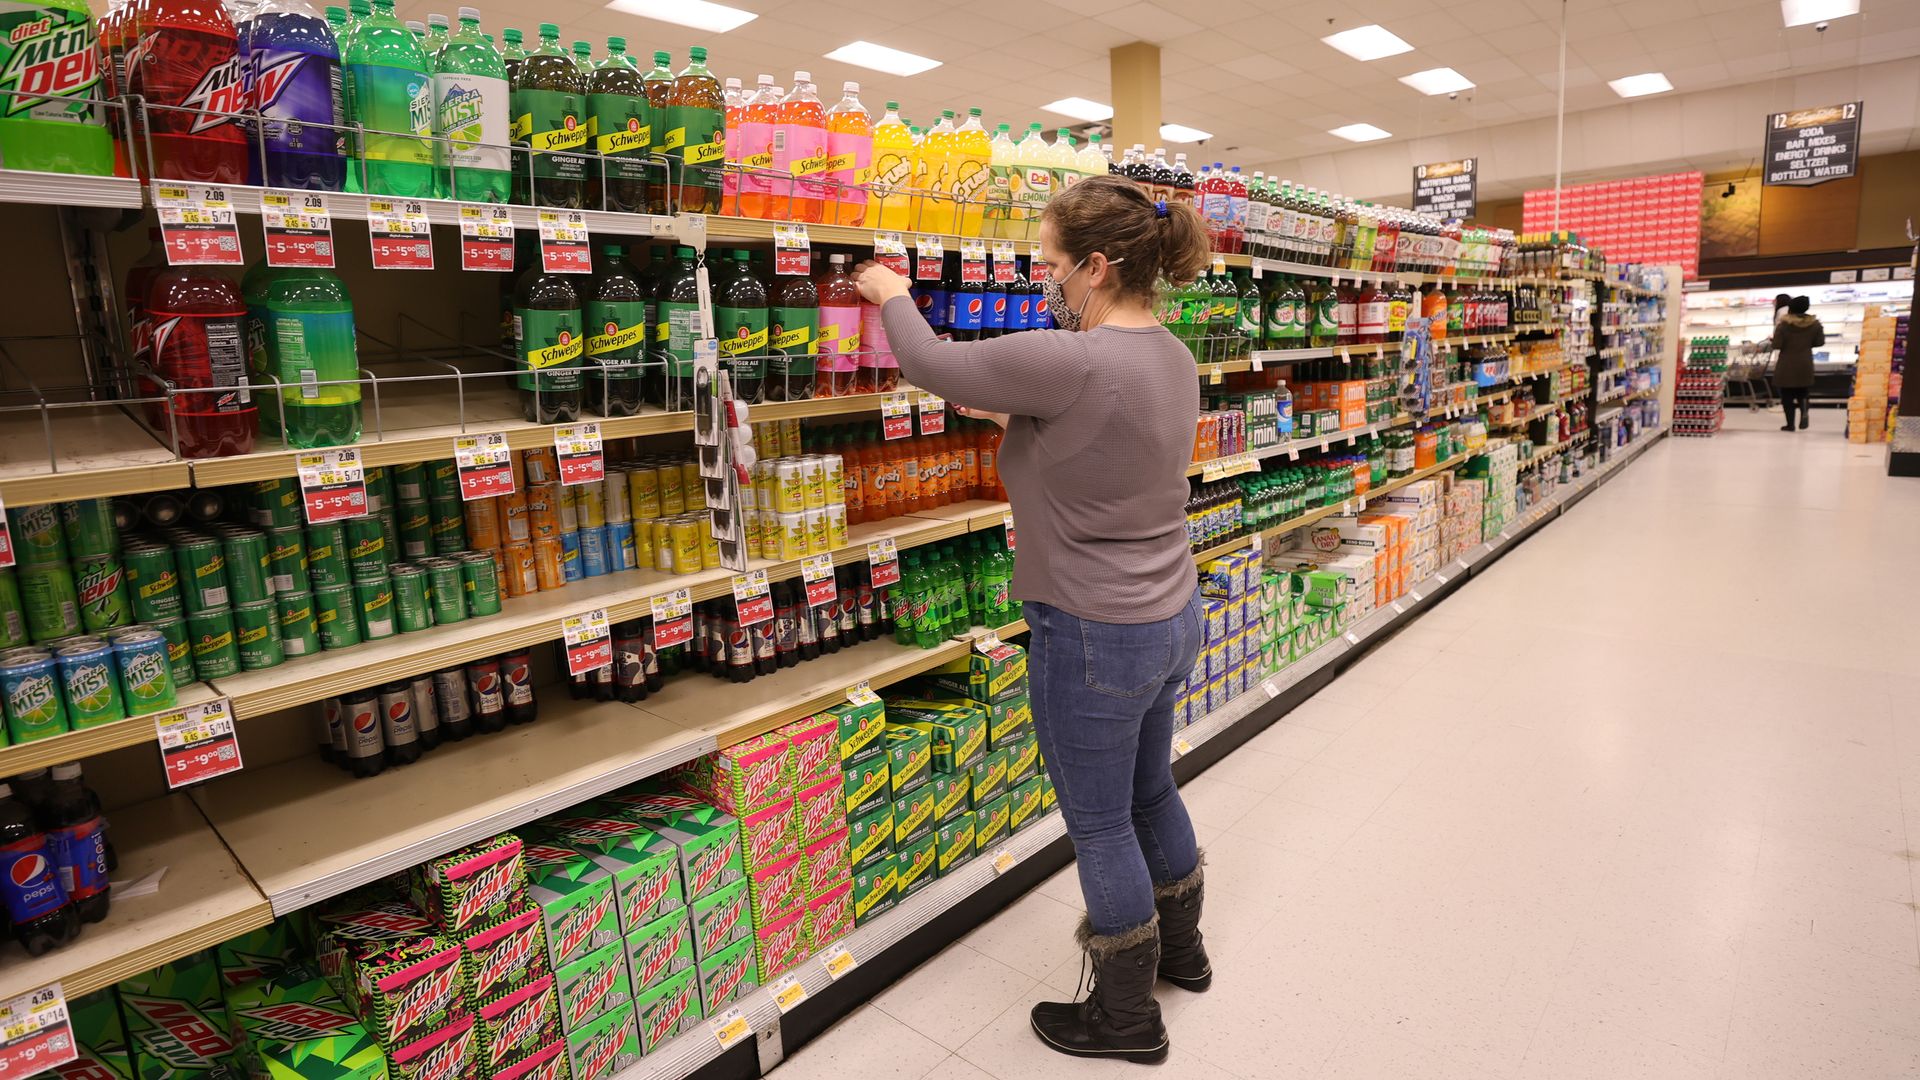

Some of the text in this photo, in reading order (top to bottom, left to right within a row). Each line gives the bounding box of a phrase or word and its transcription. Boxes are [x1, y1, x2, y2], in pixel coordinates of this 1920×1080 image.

[11, 18, 50, 42] diet
[11, 28, 85, 73] Mtn
[1774, 114, 1787, 128] 12
[1842, 103, 1856, 119] 12
[1799, 126, 1824, 138] SODA
[1786, 135, 1836, 149] BAR MIXES
[1775, 144, 1847, 161] ENERGY DRINKS
[1790, 157, 1828, 169] SELTZER
[1031, 172, 1049, 184] Dole
[1771, 165, 1848, 181] BOTTLED WATER
[205, 190, 225, 201] 2.09
[1431, 193, 1456, 203] SNACKS
[305, 197, 322, 208] 2.09
[406, 204, 421, 214] 2.09
[493, 209, 507, 219] 2.09
[184, 214, 199, 223] 3.45
[285, 219, 299, 228] 3.45
[568, 214, 582, 223] 2.09
[176, 238, 187, 250] 5
[277, 242, 286, 253] 5
[381, 246, 390, 256] 5
[470, 248, 478, 258] 5
[590, 332, 636, 352] Schweppes
[723, 333, 764, 353] Schweppes
[618, 359, 631, 367] ALE
[1253, 394, 1276, 417] mini
[1321, 410, 1339, 431] mini
[584, 425, 596, 434] 2.09
[1253, 422, 1276, 446] mini
[488, 436, 502, 445] 2.09
[338, 451, 355, 462] 2.09
[469, 477, 477, 488] 5
[315, 499, 324, 510] 5
[676, 590, 687, 599] 4.49
[591, 611, 603, 621] 4.49
[575, 652, 582, 663] 5
[203, 703, 222, 716] 4.49
[844, 715, 852, 724] 12
[848, 720, 882, 753] Schweppes
[895, 749, 903, 758] 12
[176, 759, 187, 771] 5
[849, 770, 857, 779] 12
[854, 823, 862, 832] 12
[23, 882, 55, 903] pepsi
[31, 990, 54, 1005] 4.49
